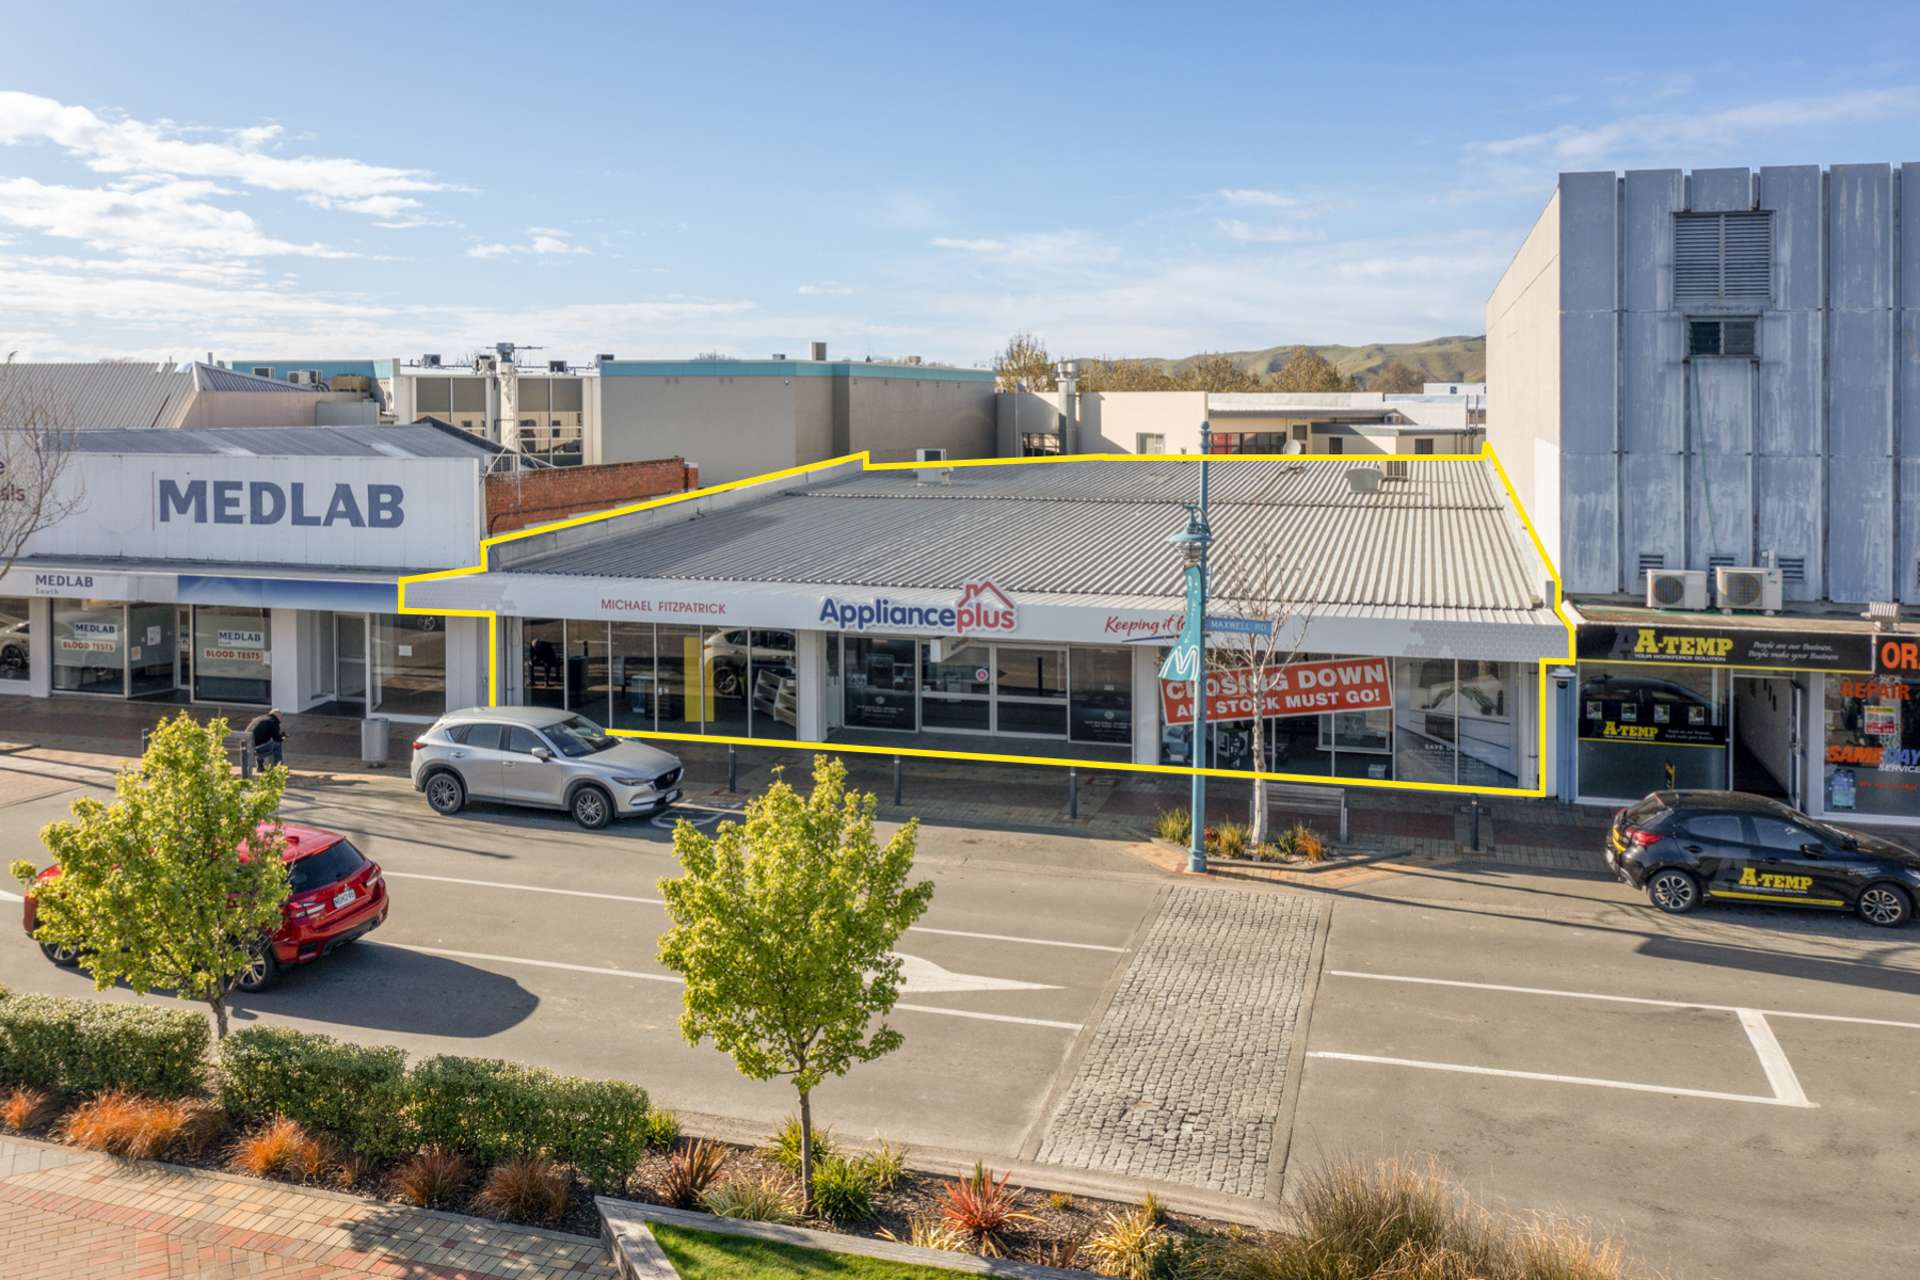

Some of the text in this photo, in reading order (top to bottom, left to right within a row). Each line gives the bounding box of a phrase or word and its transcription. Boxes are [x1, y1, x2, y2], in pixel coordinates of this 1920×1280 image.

[159, 479, 405, 528] MEDLAB
[35, 574, 94, 587] MEDLAB
[600, 599, 726, 614] MICHAEL FITZPATRICK
[75, 624, 115, 634] MEDLAB
[1104, 615, 1159, 636] Keeping
[1162, 614, 1176, 631] it
[1211, 619, 1250, 630] MAXWELL
[63, 641, 114, 651] BLOOD TESTS
[219, 632, 260, 642] MEDLAB
[1634, 628, 1733, 656] A-TEMP
[206, 650, 260, 660] BLOOD TESTS
[1881, 641, 1920, 669] OR
[1298, 664, 1385, 688] DOWN
[1840, 680, 1910, 700] REPAIR
[1176, 689, 1381, 718] AL STOK MUST GO!
[1603, 721, 1659, 738] A-TEMP
[1738, 867, 1813, 890] A-TEMP
